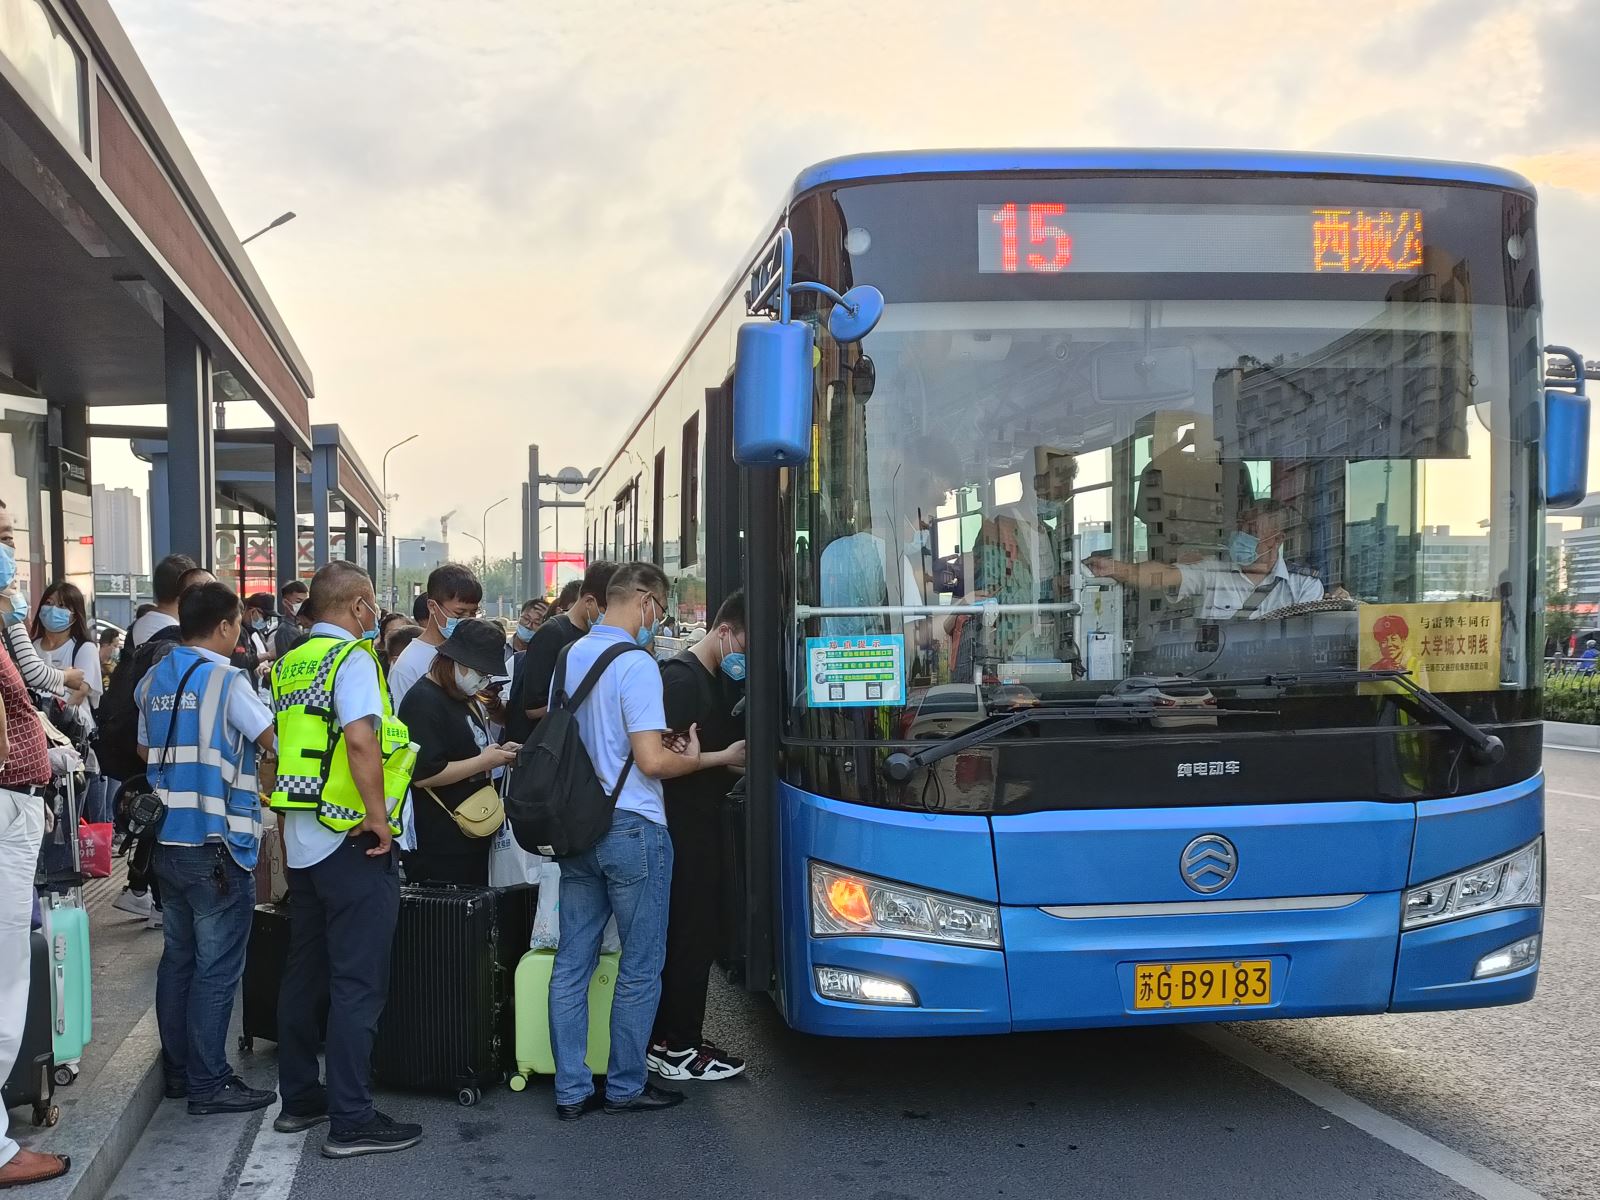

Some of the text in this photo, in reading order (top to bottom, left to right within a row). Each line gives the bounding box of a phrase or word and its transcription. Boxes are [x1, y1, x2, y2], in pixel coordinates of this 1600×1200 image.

[992, 202, 1072, 273] 15
[1420, 615, 1490, 629] 与雷锋车同行
[1420, 634, 1489, 656] 大学城文明线
[281, 659, 318, 680] 公交安保
[1177, 761, 1240, 777] 纯电动车
